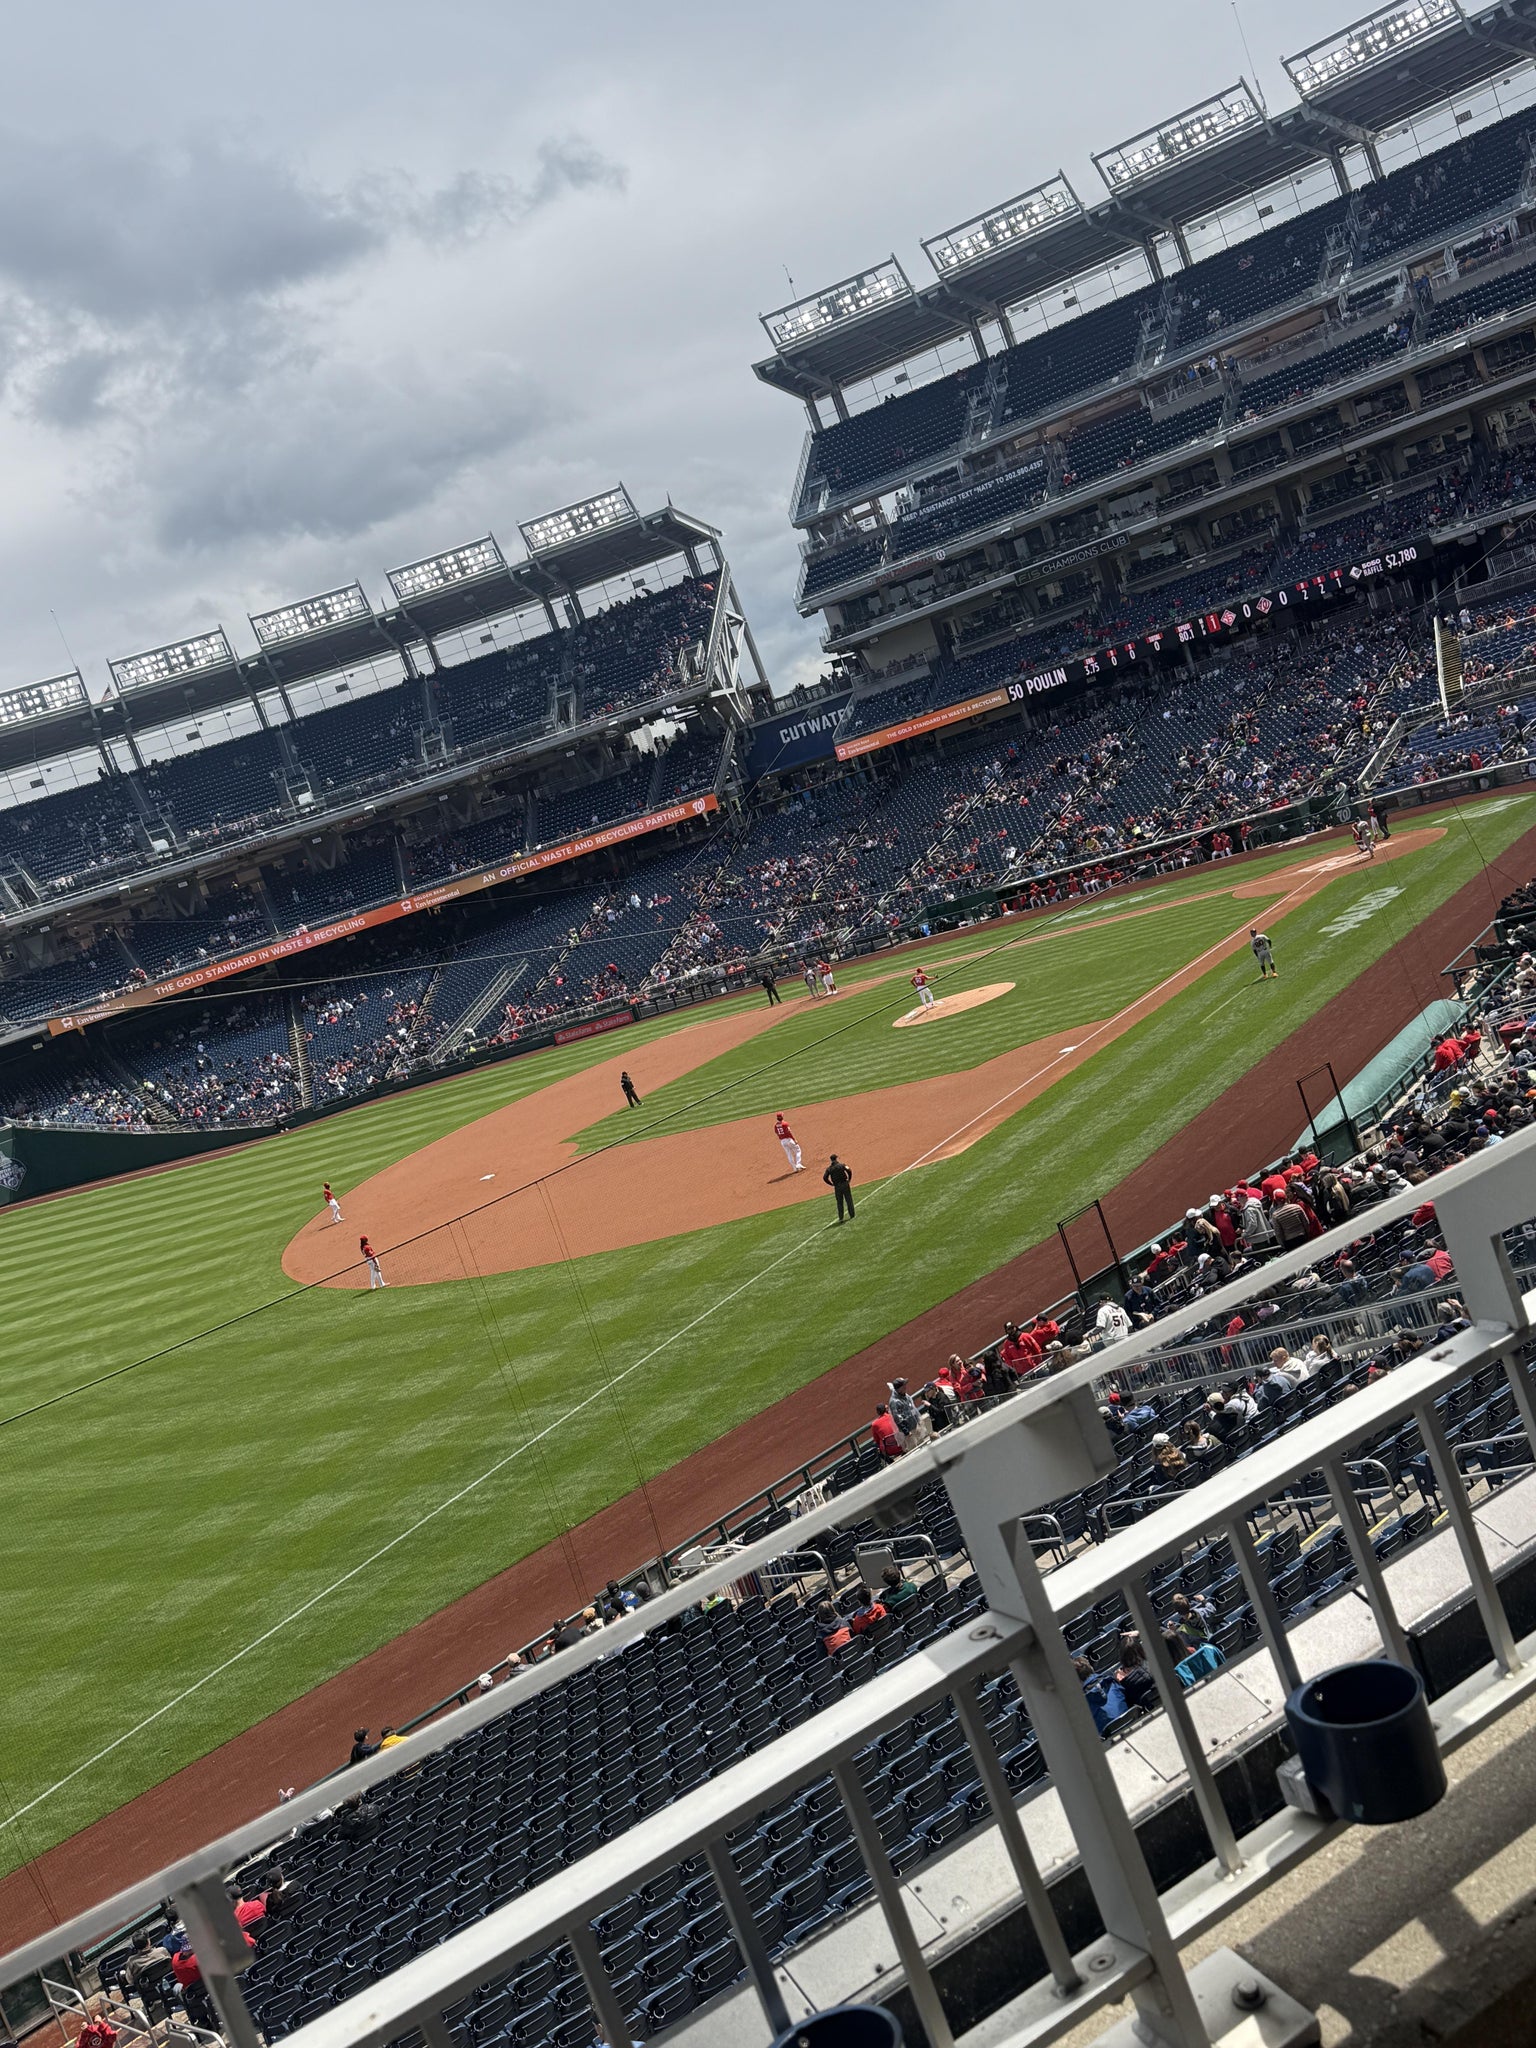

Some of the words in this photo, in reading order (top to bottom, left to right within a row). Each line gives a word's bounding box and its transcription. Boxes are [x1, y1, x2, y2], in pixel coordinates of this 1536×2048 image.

[902, 511, 919, 523] NEED
[918, 496, 958, 516] ASSISTANCE?
[957, 489, 974, 501] TEXT
[973, 480, 995, 496] "NATS"
[995, 476, 1005, 485] TO
[1041, 546, 1099, 575] CHAMPIONS
[1100, 535, 1127, 552] CLUB
[1384, 546, 1418, 569] $2,780
[1362, 564, 1384, 577] RAFFLE
[1301, 589, 1309, 601] 2
[1318, 583, 1327, 595] 2
[1278, 590, 1289, 606] 0
[1242, 603, 1252, 618] 0
[1178, 627, 1195, 644] 80.1
[1153, 641, 1161, 652] 0
[1110, 656, 1119, 667] 0
[1129, 650, 1137, 660] 0
[1085, 661, 1101, 677] 3.75
[1008, 684, 1025, 702] 50
[1025, 667, 1068, 695] POULIN
[886, 730, 899, 740] THE
[898, 725, 913, 738] GOLD
[912, 715, 942, 735] STANDARD
[947, 706, 968, 720] WASTE
[971, 694, 1003, 711] RECYCLING
[482, 872, 496, 884] AN
[499, 857, 542, 878] OFFICIAL
[541, 845, 573, 864] WASTE
[573, 839, 595, 853] AND
[594, 820, 645, 849] RECYCLING
[645, 807, 687, 828] PARTNER
[413, 892, 433, 902] GOLDEN
[433, 887, 447, 896] BEAR
[415, 888, 461, 910] Environmental
[154, 983, 176, 996] THE
[176, 972, 205, 990] GOLD
[205, 954, 258, 980] STANDARD
[257, 950, 270, 962] IN
[270, 937, 304, 957] WASTE
[305, 936, 313, 946] &
[313, 917, 367, 943] RECYCLING
[1112, 1315, 1126, 1327] 51
